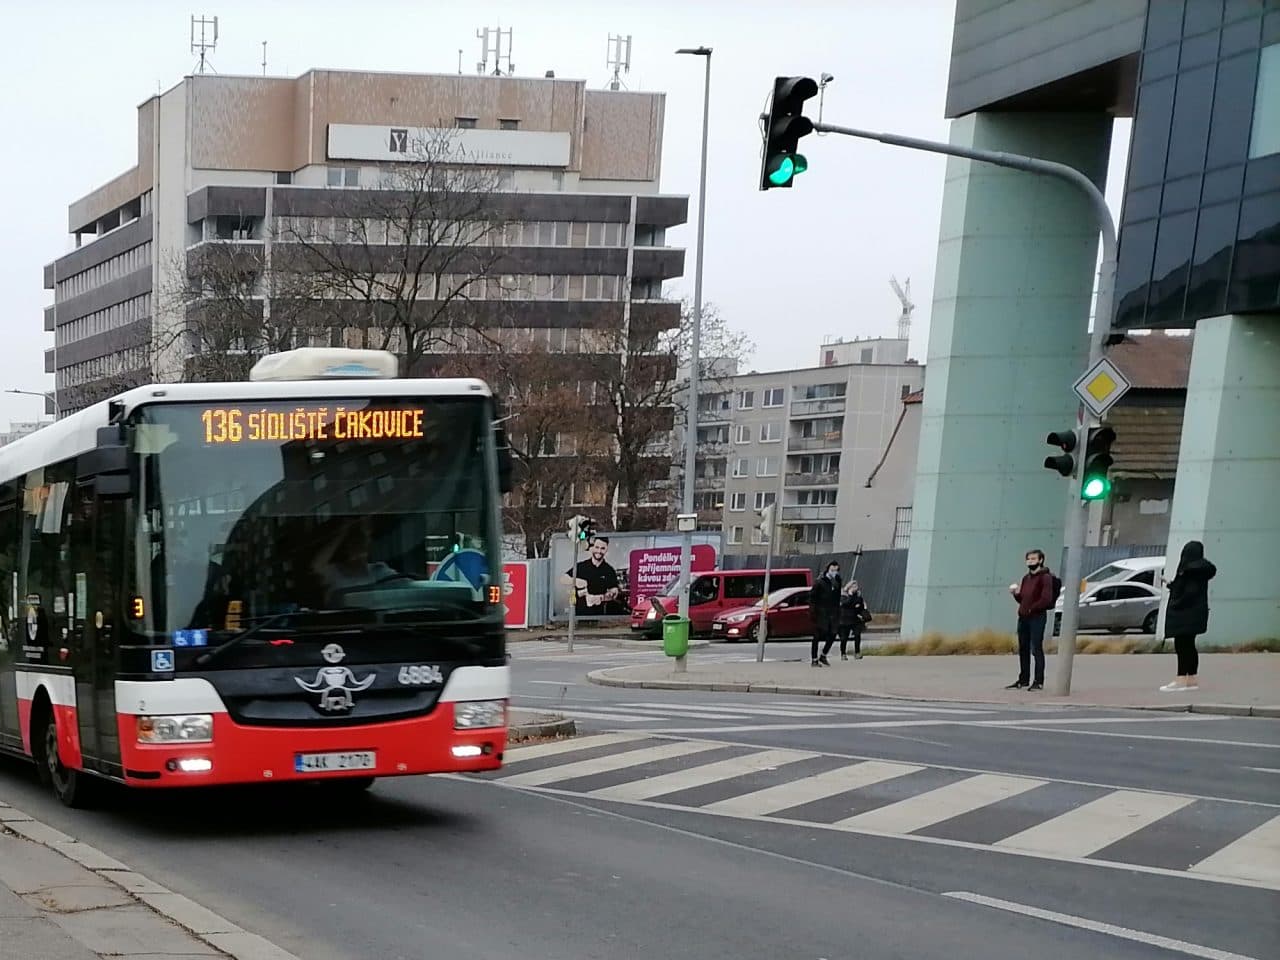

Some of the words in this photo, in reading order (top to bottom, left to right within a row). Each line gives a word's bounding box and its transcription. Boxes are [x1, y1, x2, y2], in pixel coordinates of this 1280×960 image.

[202, 409, 243, 443] 136
[248, 408, 328, 440] SÍDLIŠTĚ
[334, 407, 424, 439] ČAKOVICE
